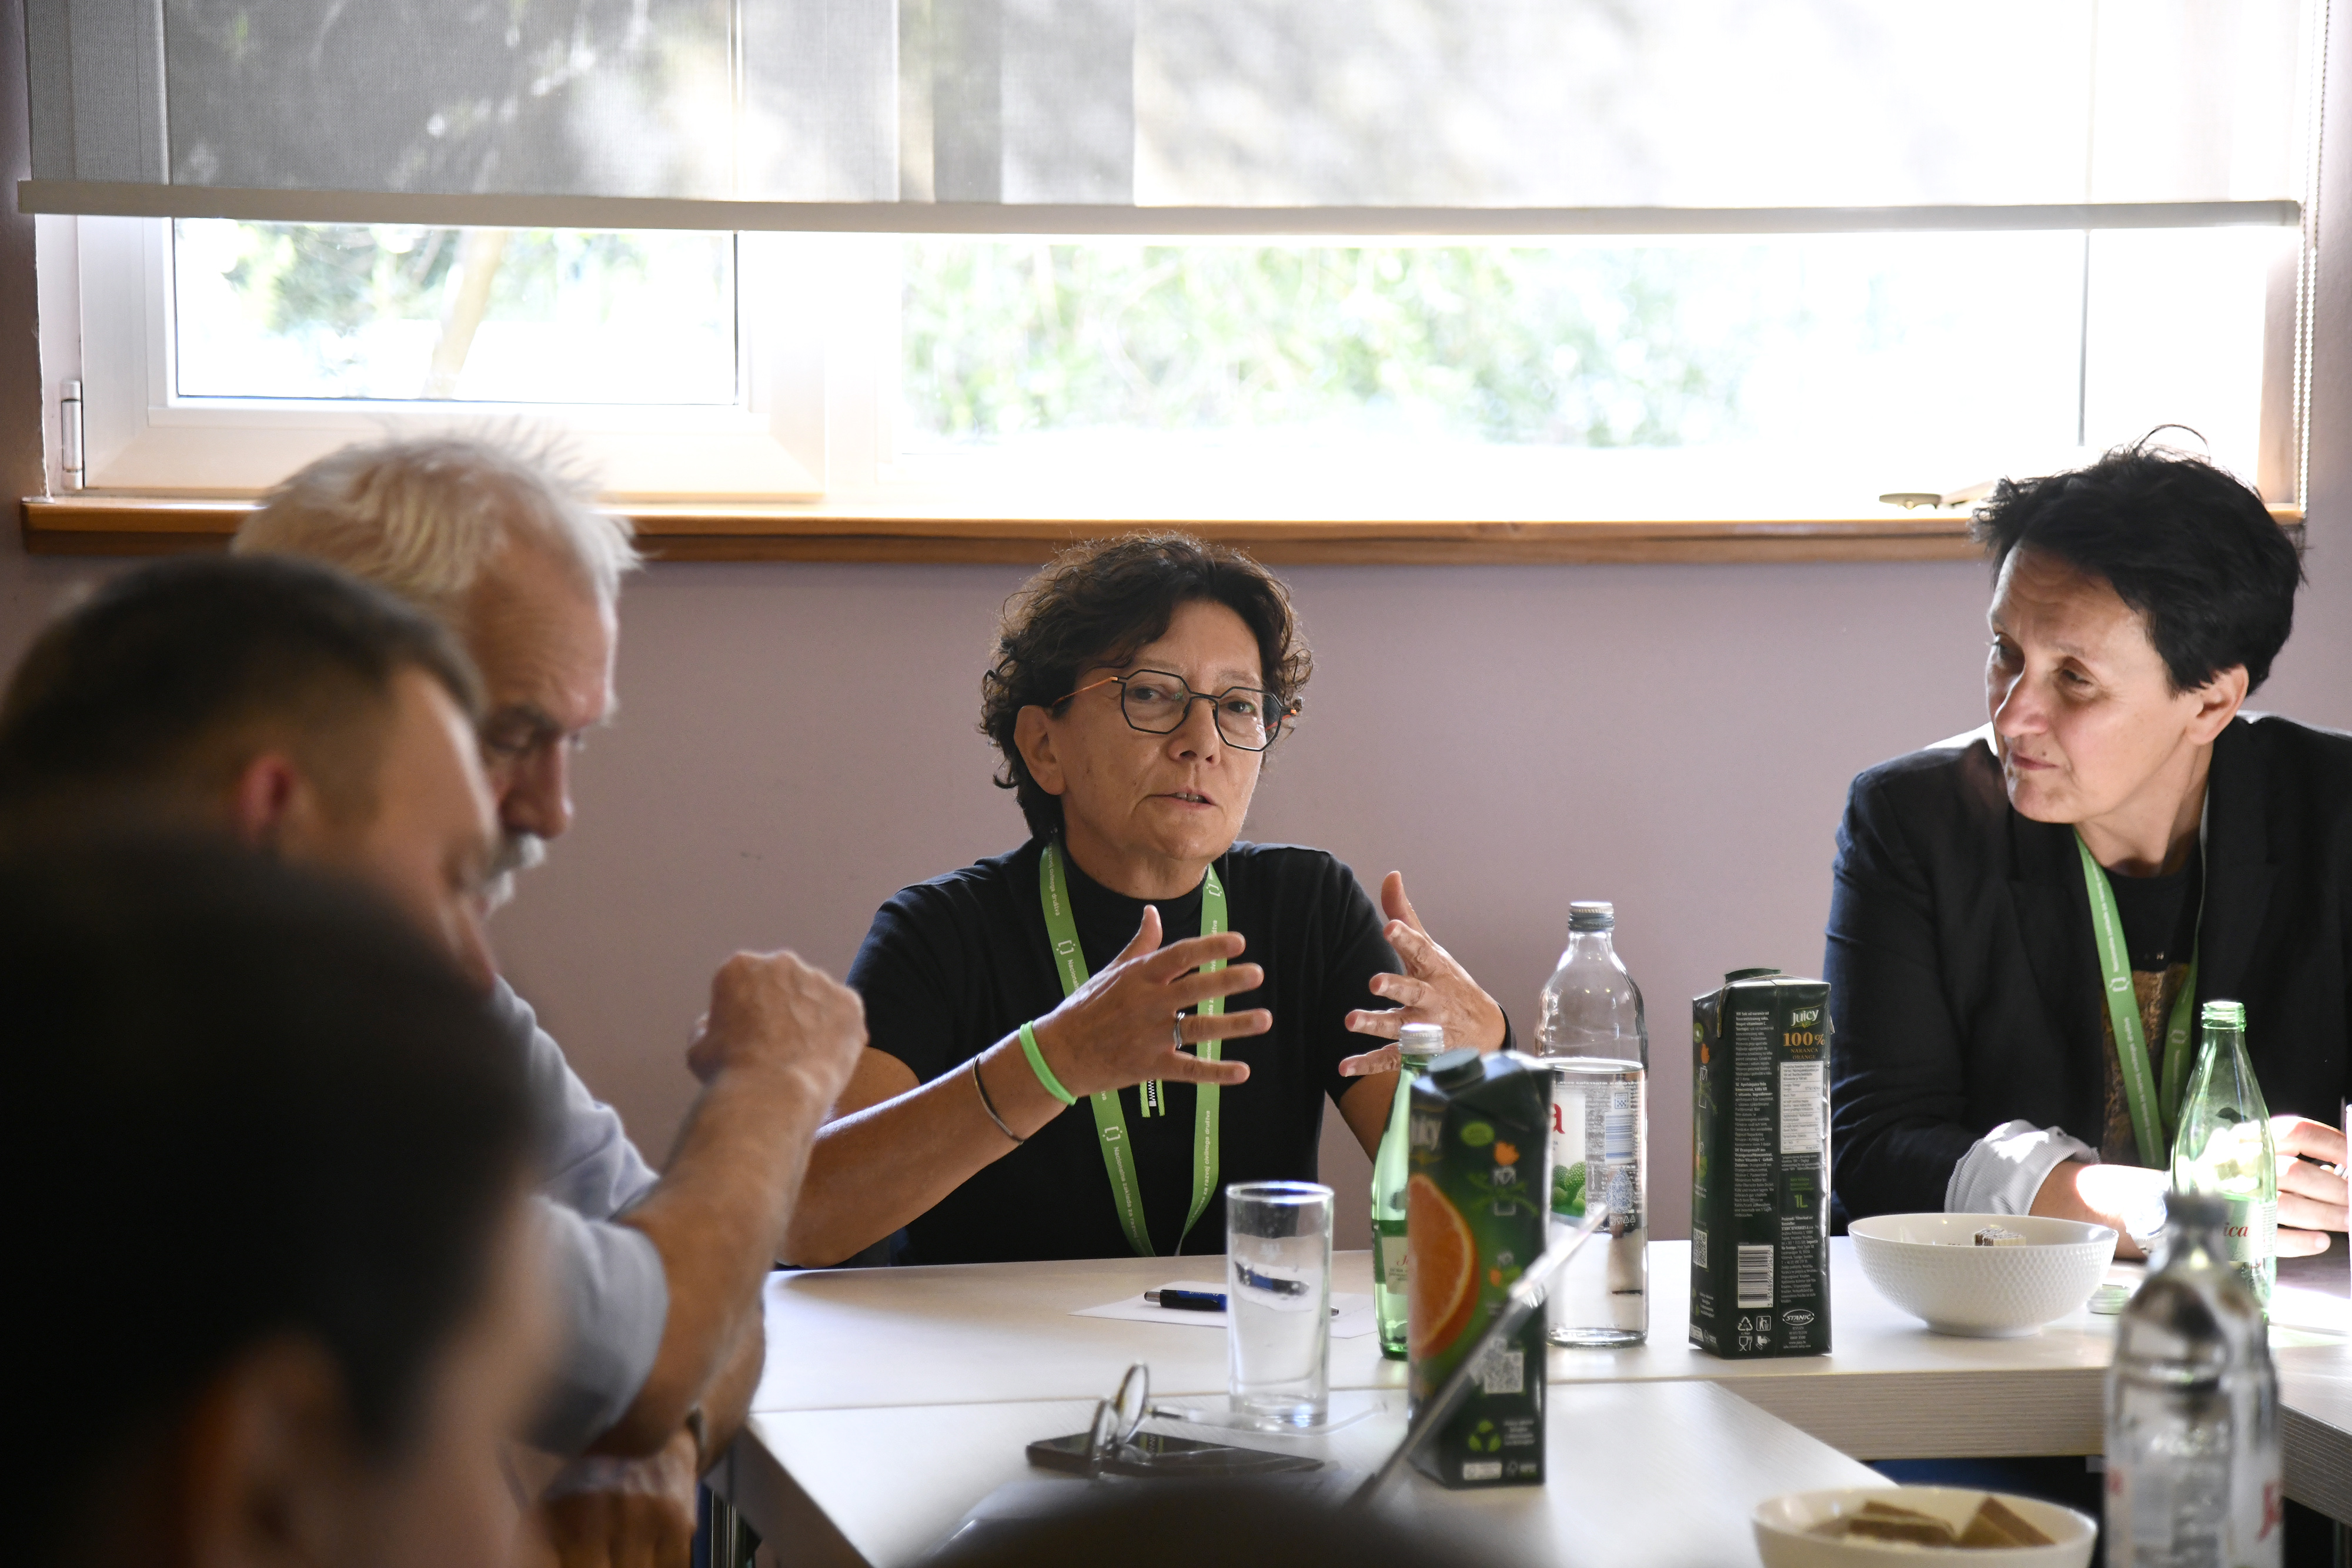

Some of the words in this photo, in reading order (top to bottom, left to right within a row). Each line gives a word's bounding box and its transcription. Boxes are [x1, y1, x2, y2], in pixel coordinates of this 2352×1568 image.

[1051, 893, 1060, 916] društva
[1068, 959, 1080, 990] Nacionaln
[1790, 1009, 1819, 1027] Juicy
[1114, 1146, 1126, 1182] Nacionalna
[1122, 1182, 1132, 1208] zaklada
[1128, 1208, 1133, 1217] za
[1795, 1194, 1808, 1208] 1L
